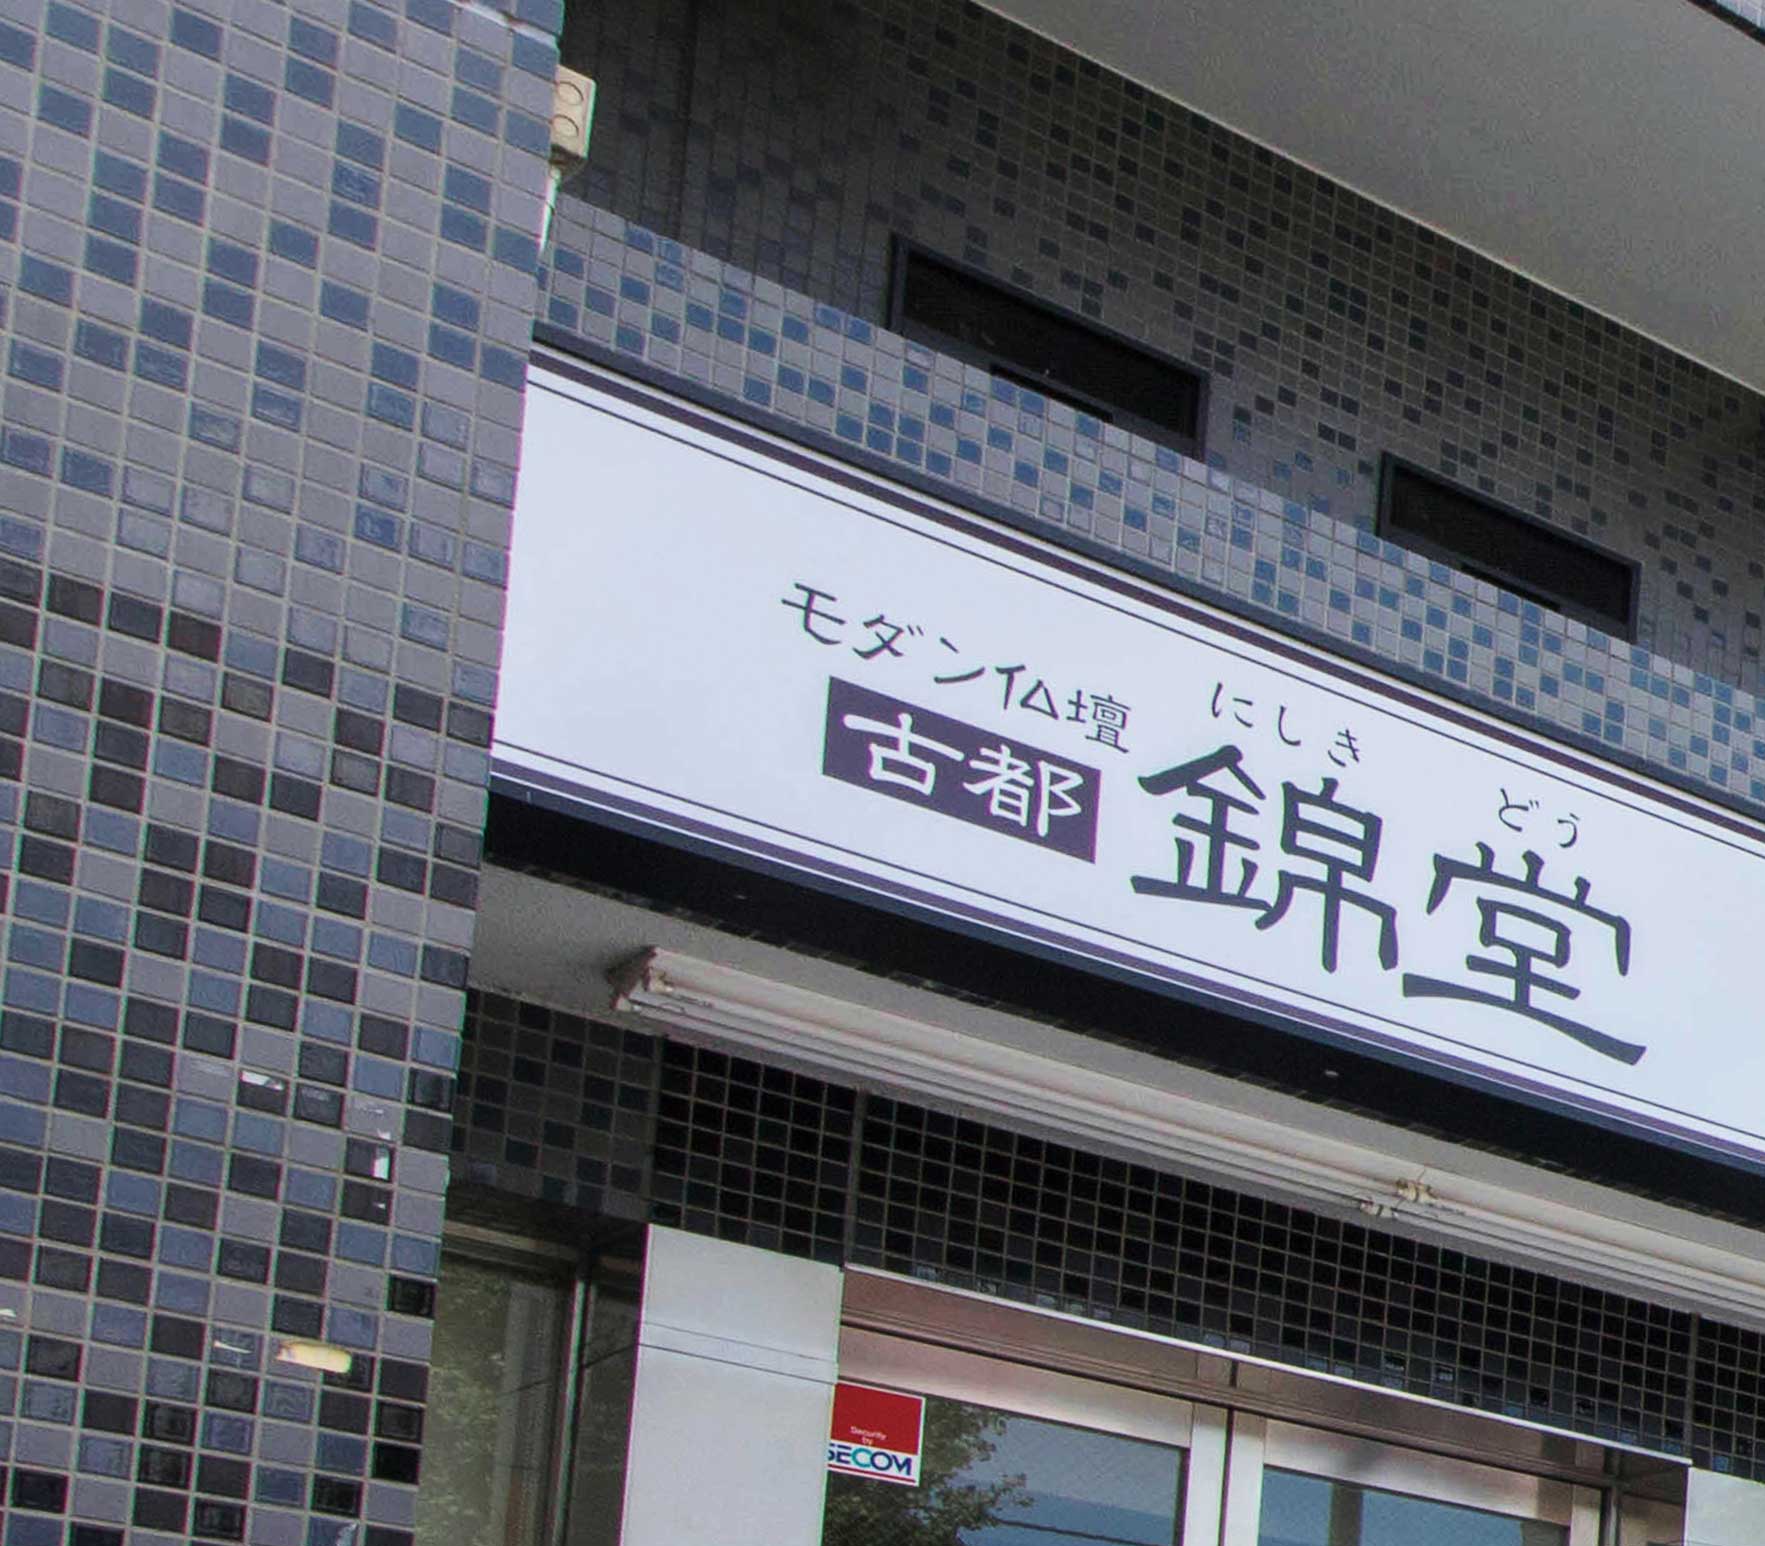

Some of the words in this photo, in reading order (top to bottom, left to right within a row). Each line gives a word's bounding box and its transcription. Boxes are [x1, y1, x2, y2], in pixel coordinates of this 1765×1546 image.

[781, 575, 1132, 754] モダン仏壇
[841, 712, 1085, 838] 古都
[1210, 682, 1360, 768] にしき
[1497, 788, 1582, 849] どう
[1130, 744, 1648, 1067] 錦堂
[828, 1442, 912, 1476] SECOM
